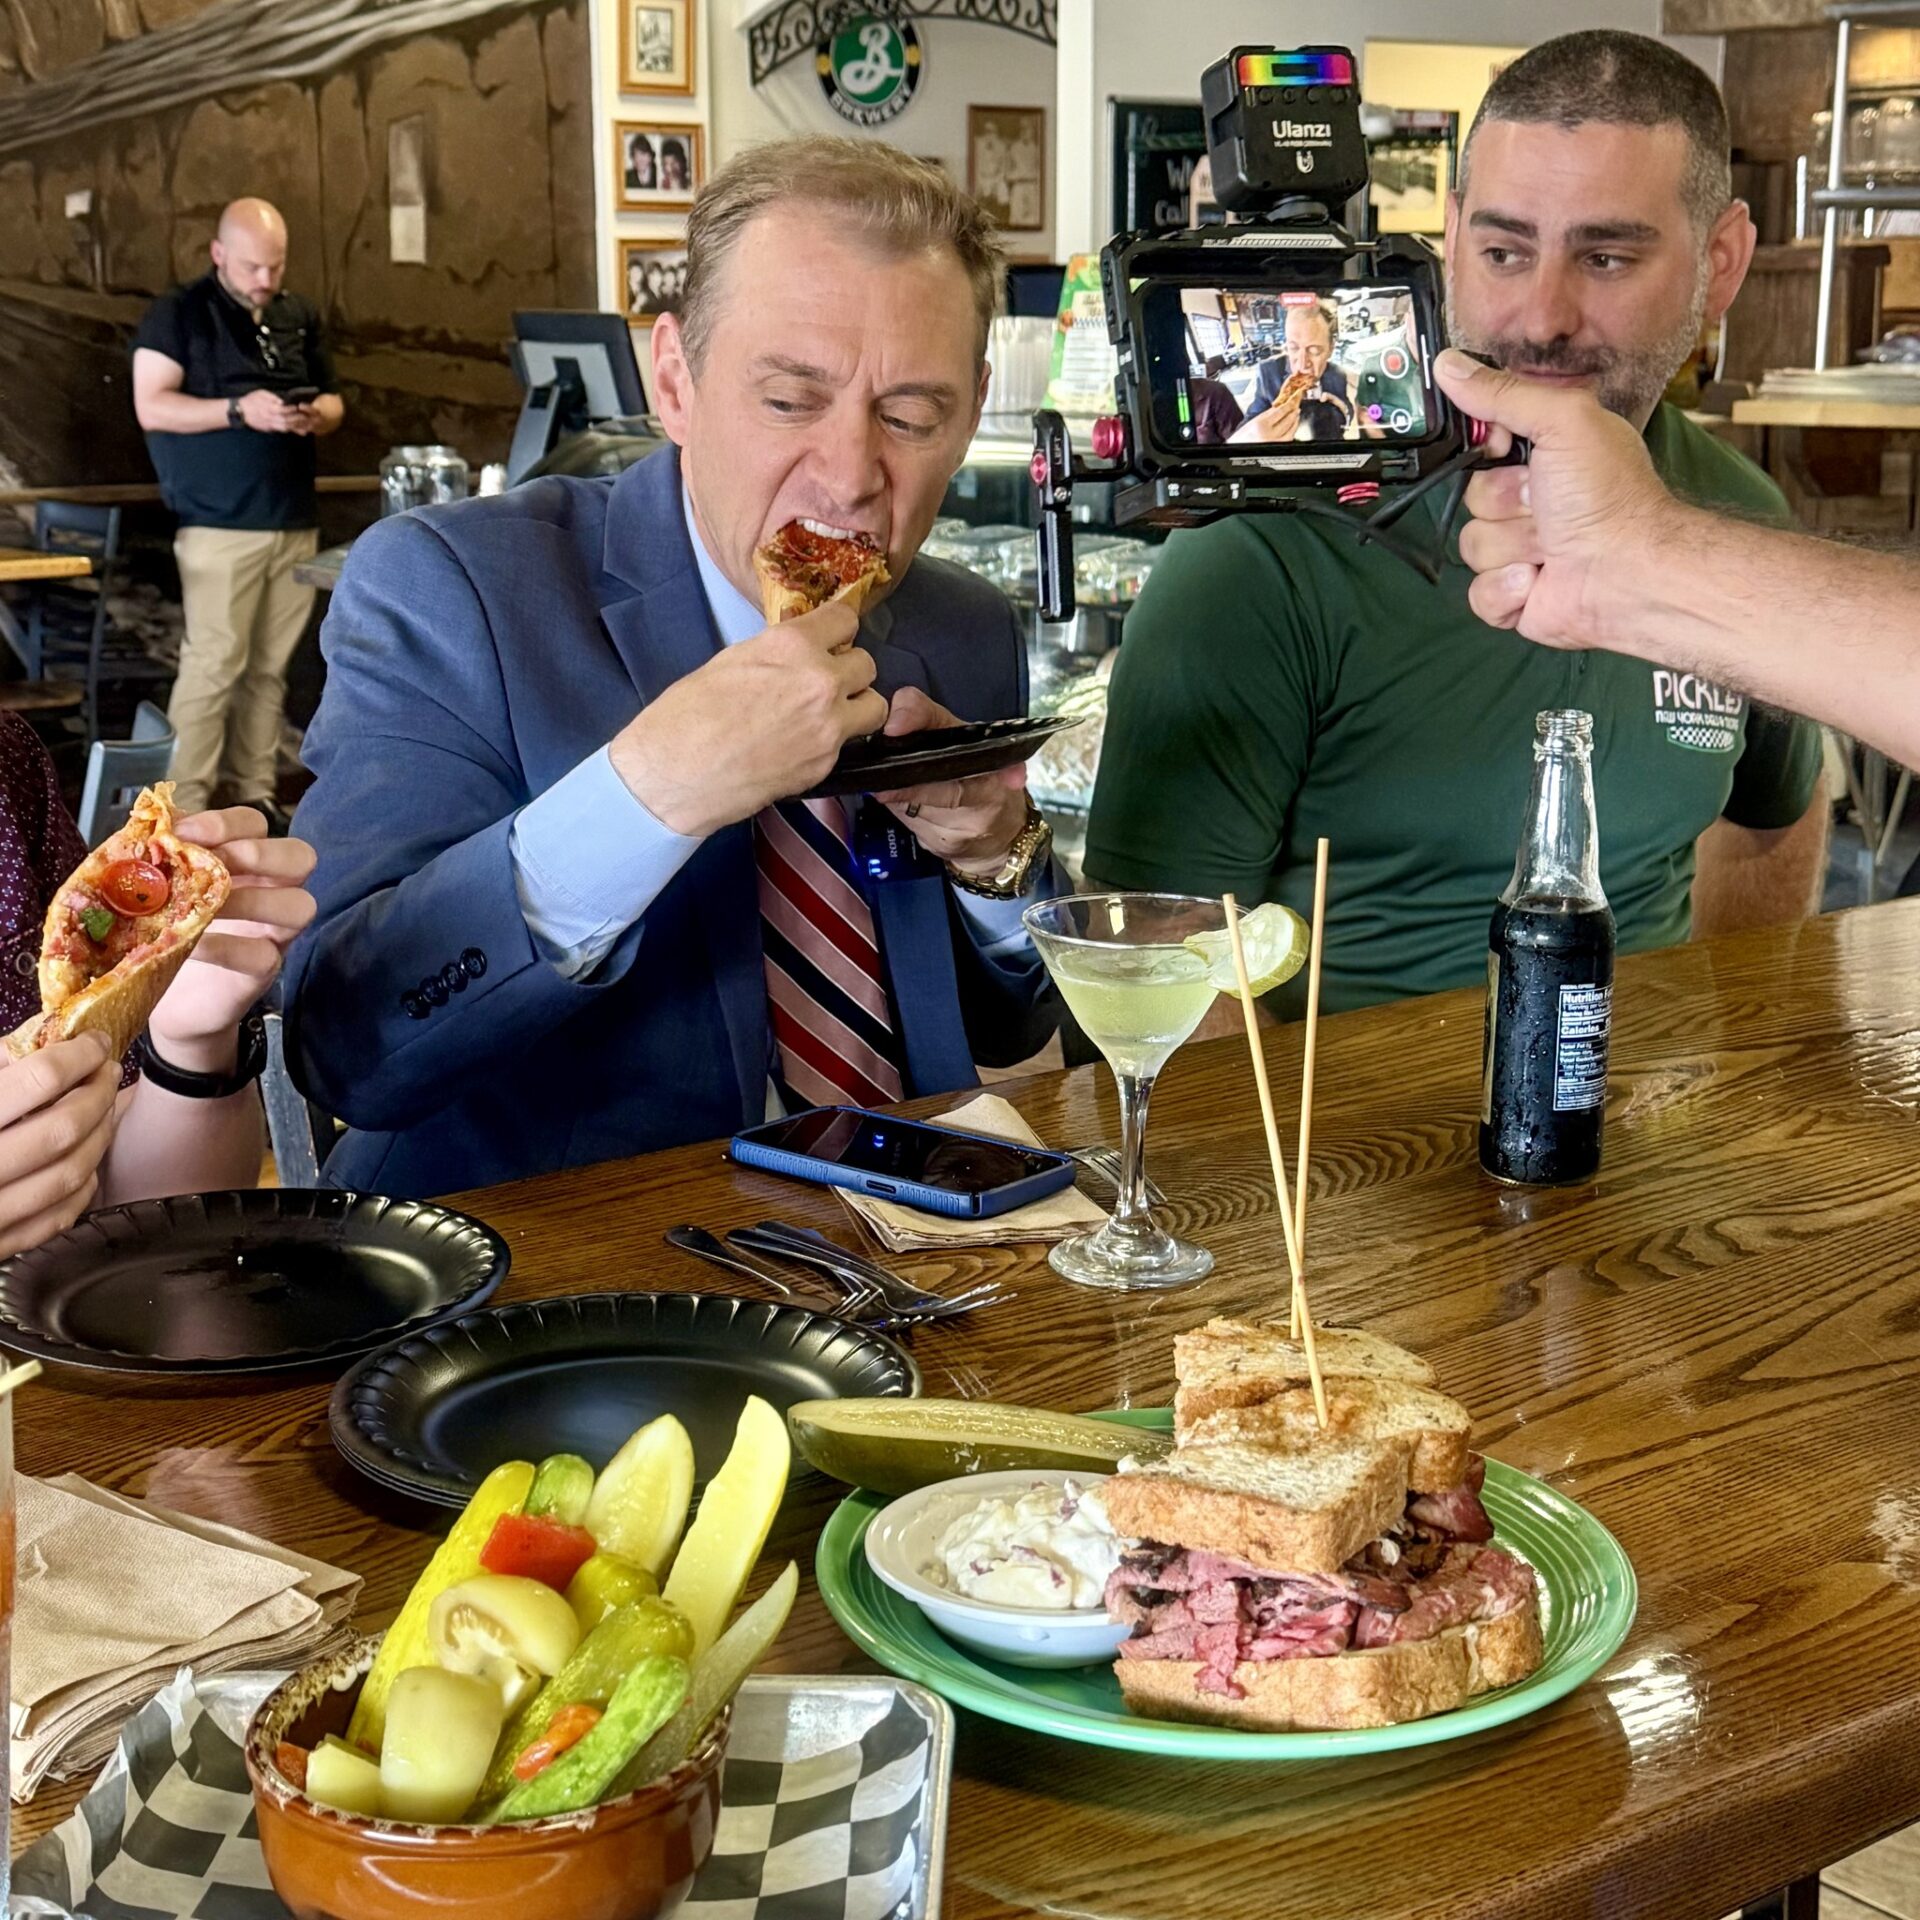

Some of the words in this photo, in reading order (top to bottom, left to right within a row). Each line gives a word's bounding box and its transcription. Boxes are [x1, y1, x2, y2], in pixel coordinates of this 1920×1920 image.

[1272, 120, 1331, 139] Ulanzi
[1562, 992, 1604, 1003] Nutrition
[1561, 1025, 1600, 1035] Calories
